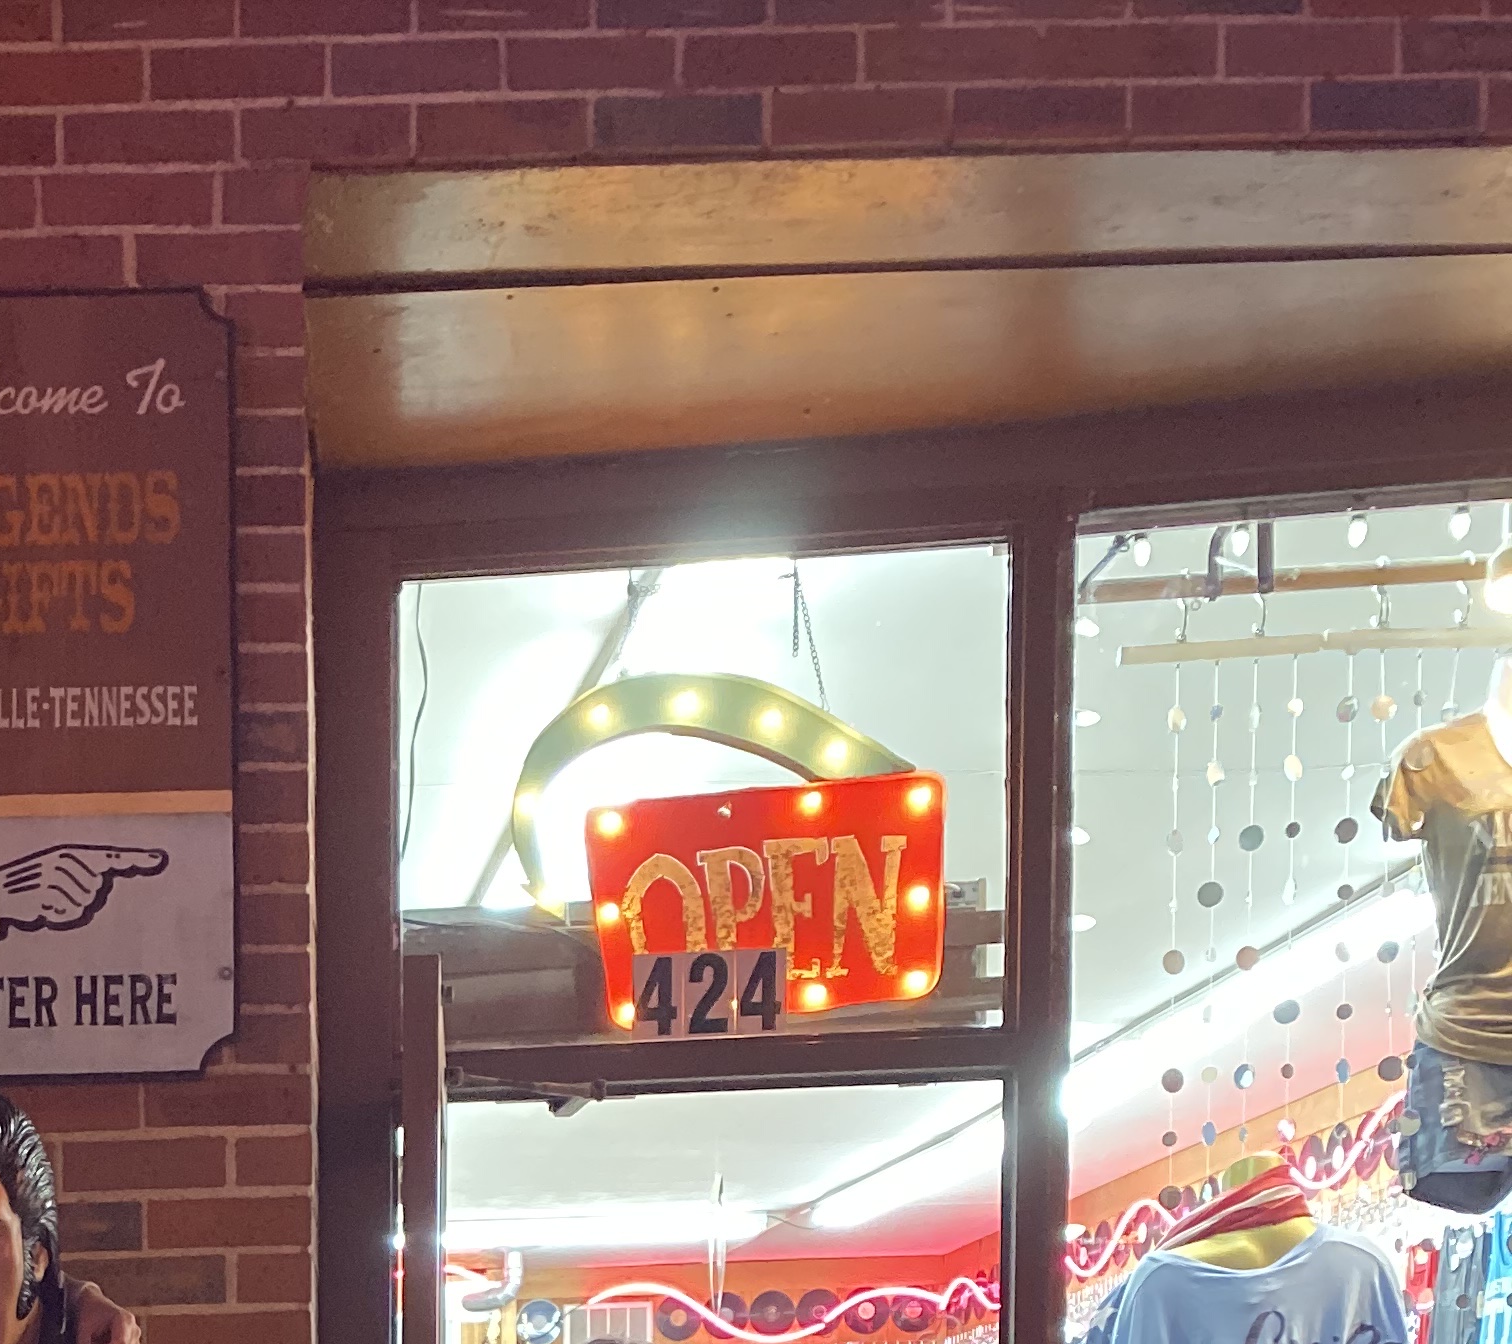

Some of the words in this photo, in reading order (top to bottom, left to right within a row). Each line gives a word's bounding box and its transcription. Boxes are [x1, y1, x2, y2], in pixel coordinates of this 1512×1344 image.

[126, 357, 186, 415] To
[74, 973, 178, 1027] HERE
[634, 950, 782, 1037] 424
